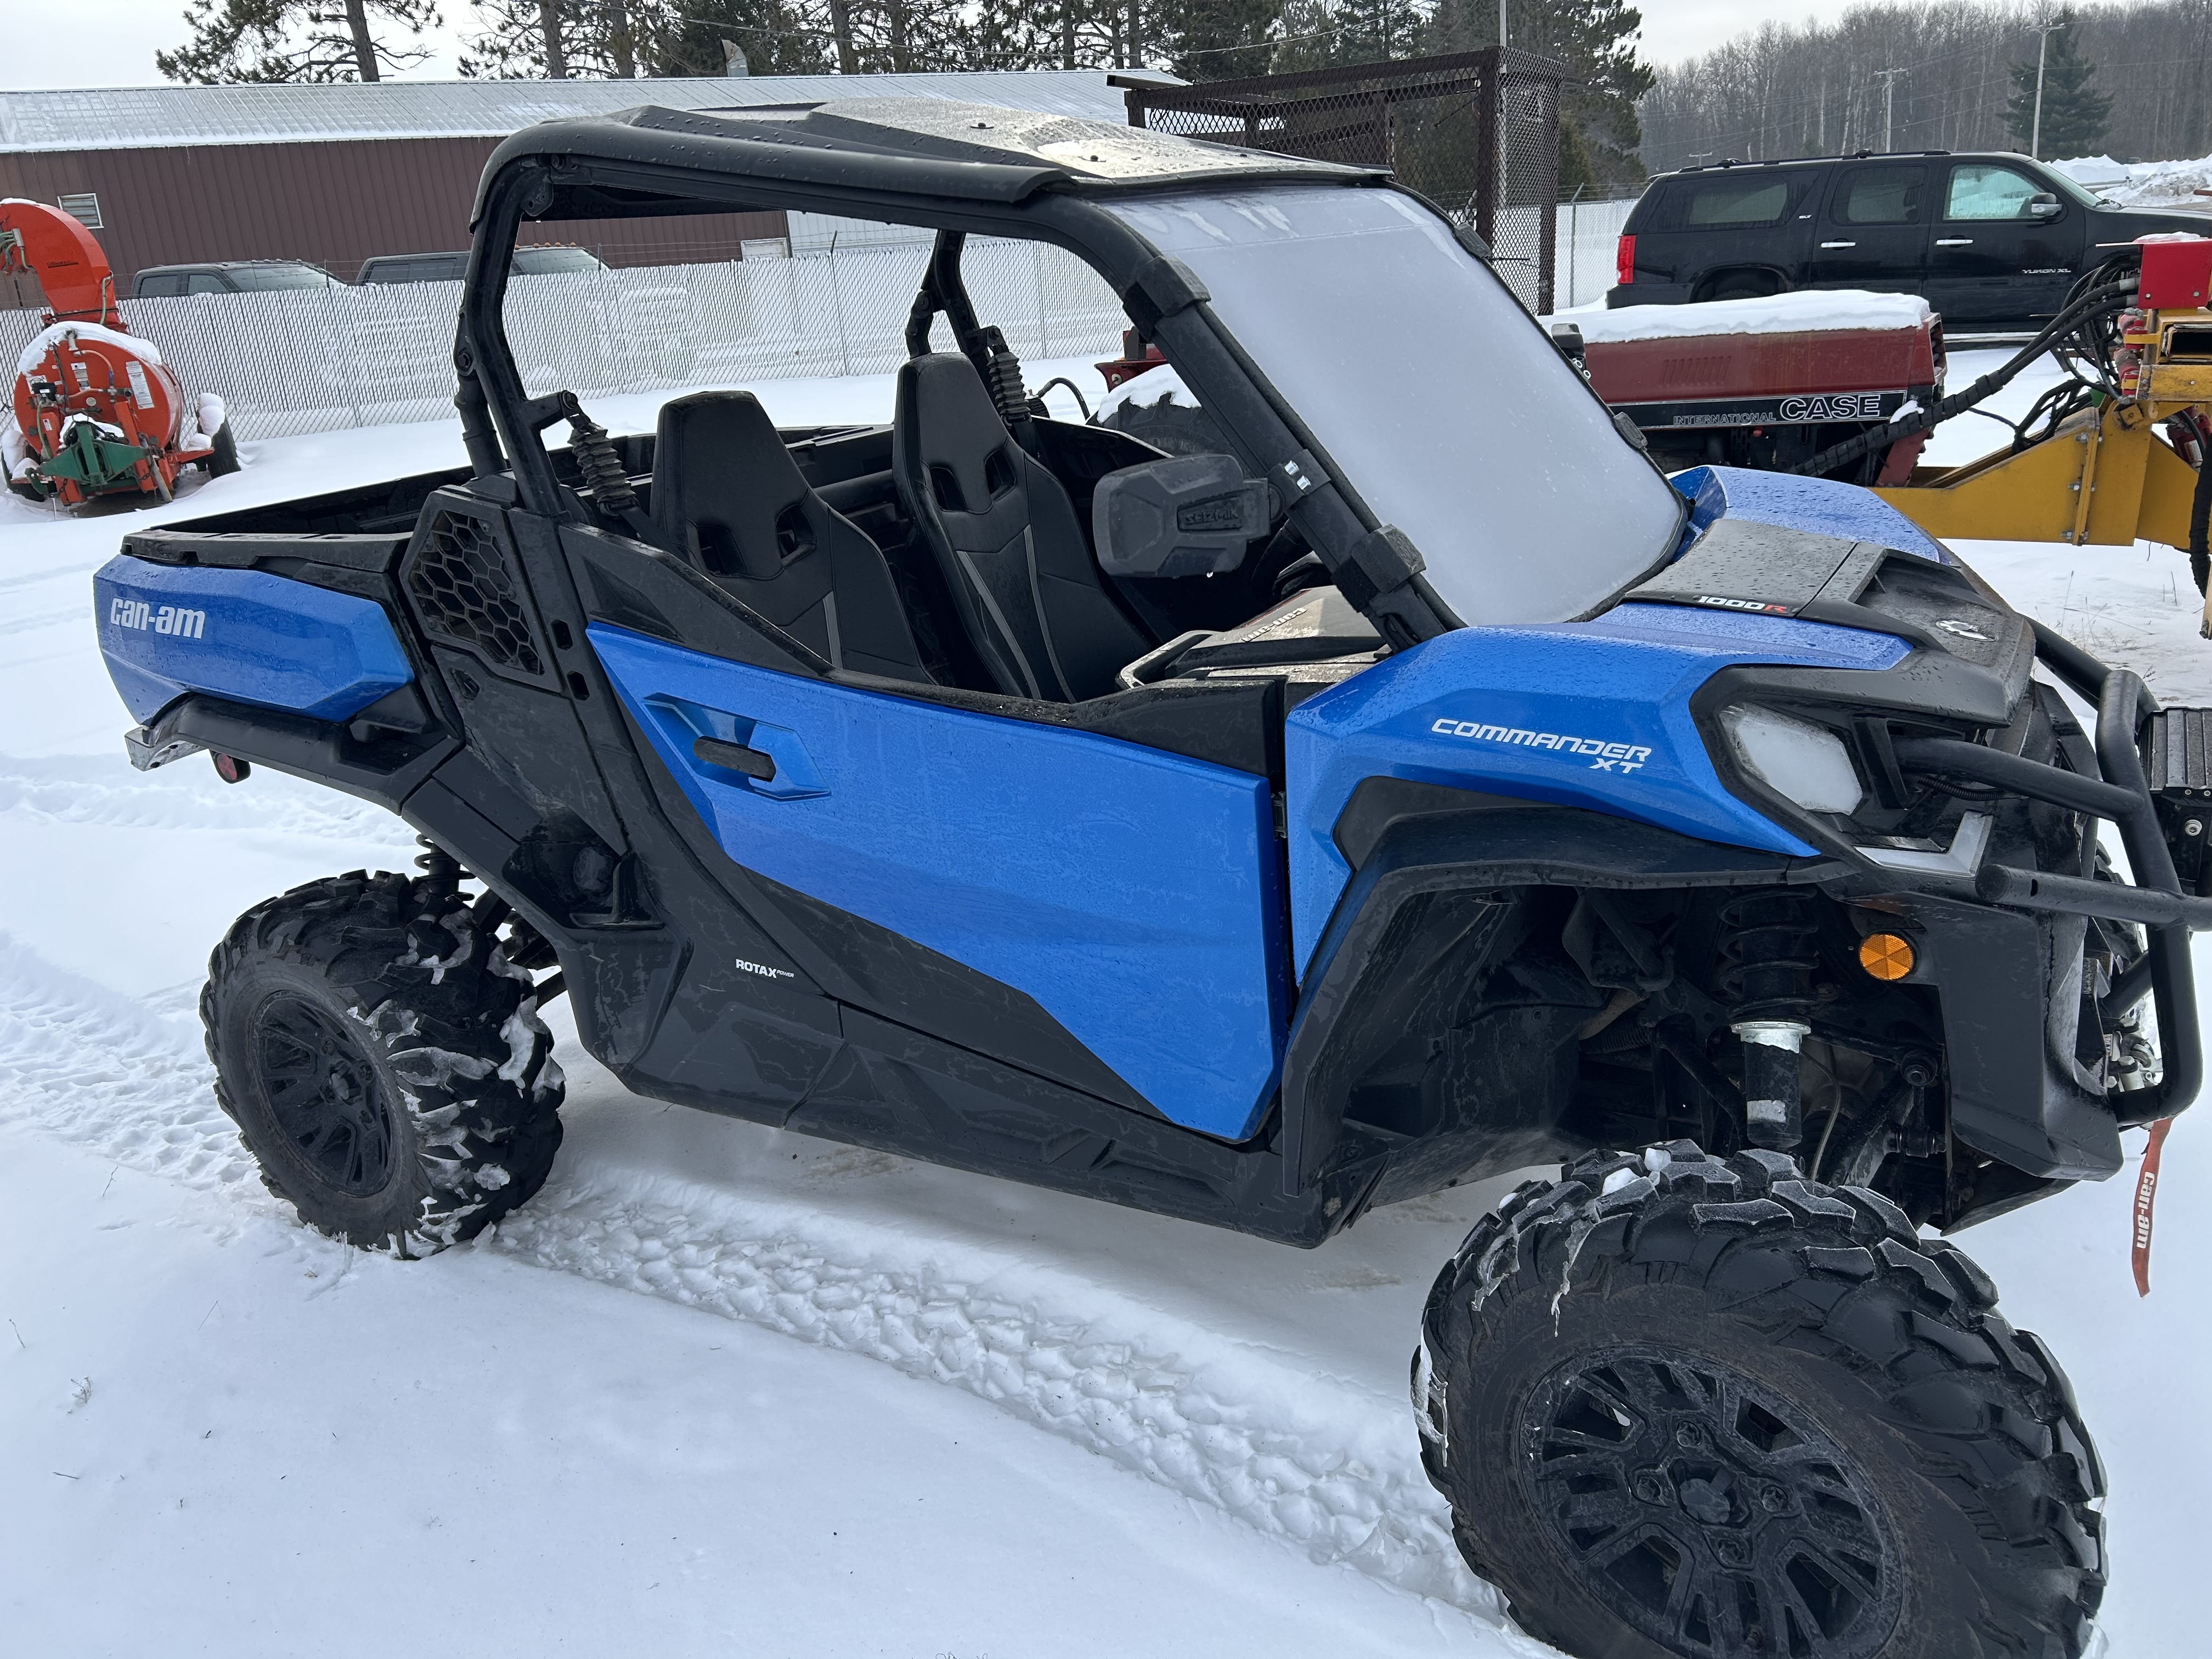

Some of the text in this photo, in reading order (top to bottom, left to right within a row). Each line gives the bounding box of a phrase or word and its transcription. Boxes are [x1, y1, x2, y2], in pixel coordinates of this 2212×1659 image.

[1673, 394, 1881, 425] INTERNATIONAL CASE
[110, 597, 205, 639] can-am
[1698, 596, 1787, 614] 1000R
[1431, 718, 1652, 761] COMMANDER
[1589, 757, 1643, 774] XT
[736, 958, 794, 978] ROTAX POWER
[2136, 1171, 2155, 1249] can-am
